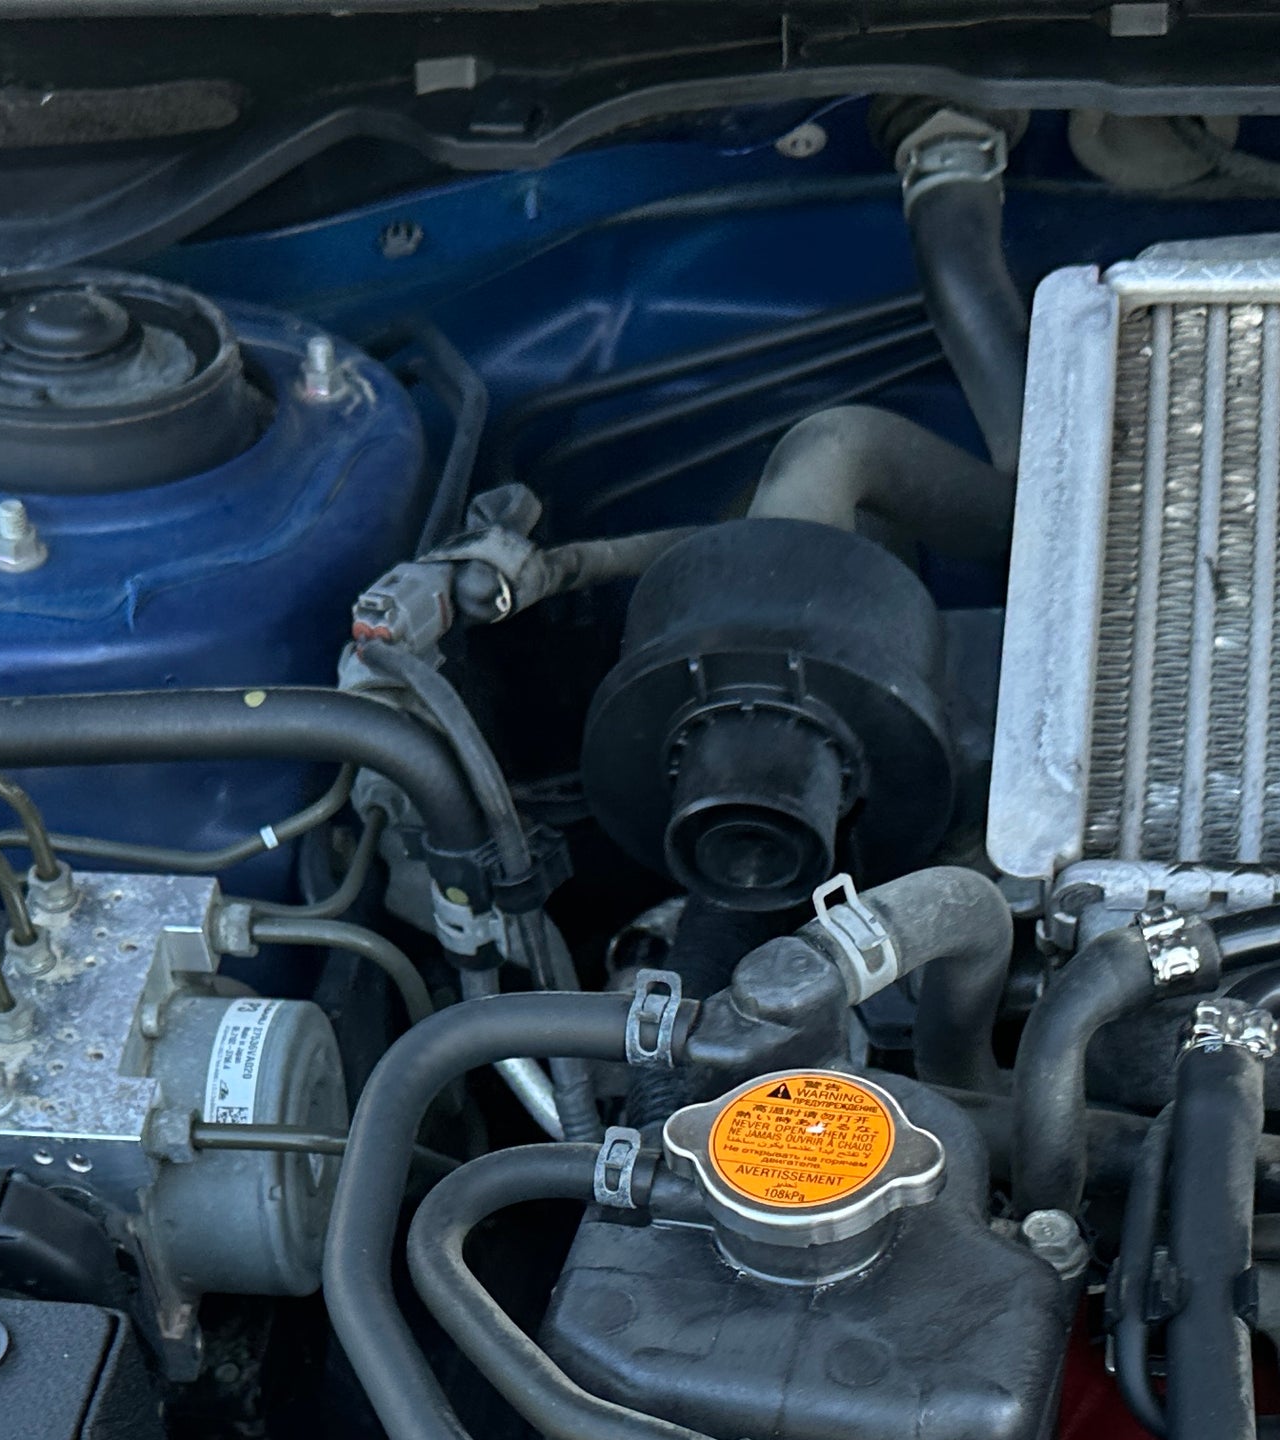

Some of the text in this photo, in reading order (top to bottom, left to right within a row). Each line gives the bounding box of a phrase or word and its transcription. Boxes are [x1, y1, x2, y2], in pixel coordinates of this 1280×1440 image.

[797, 1088, 864, 1103] WARNING
[793, 1097, 878, 1113] ПРЕДУПРЕЖДЕНИЕ
[732, 1118, 770, 1131] NEVER
[775, 1124, 806, 1135] OPEN
[728, 1127, 742, 1136] NE
[745, 1130, 781, 1141] JAMAIS
[786, 1133, 823, 1145] OUVRIR
[723, 1144, 739, 1152] Не
[742, 1148, 800, 1160] открывать
[735, 1164, 844, 1186] AVERTISSEMENT
[764, 1187, 805, 1202] 108kPa
